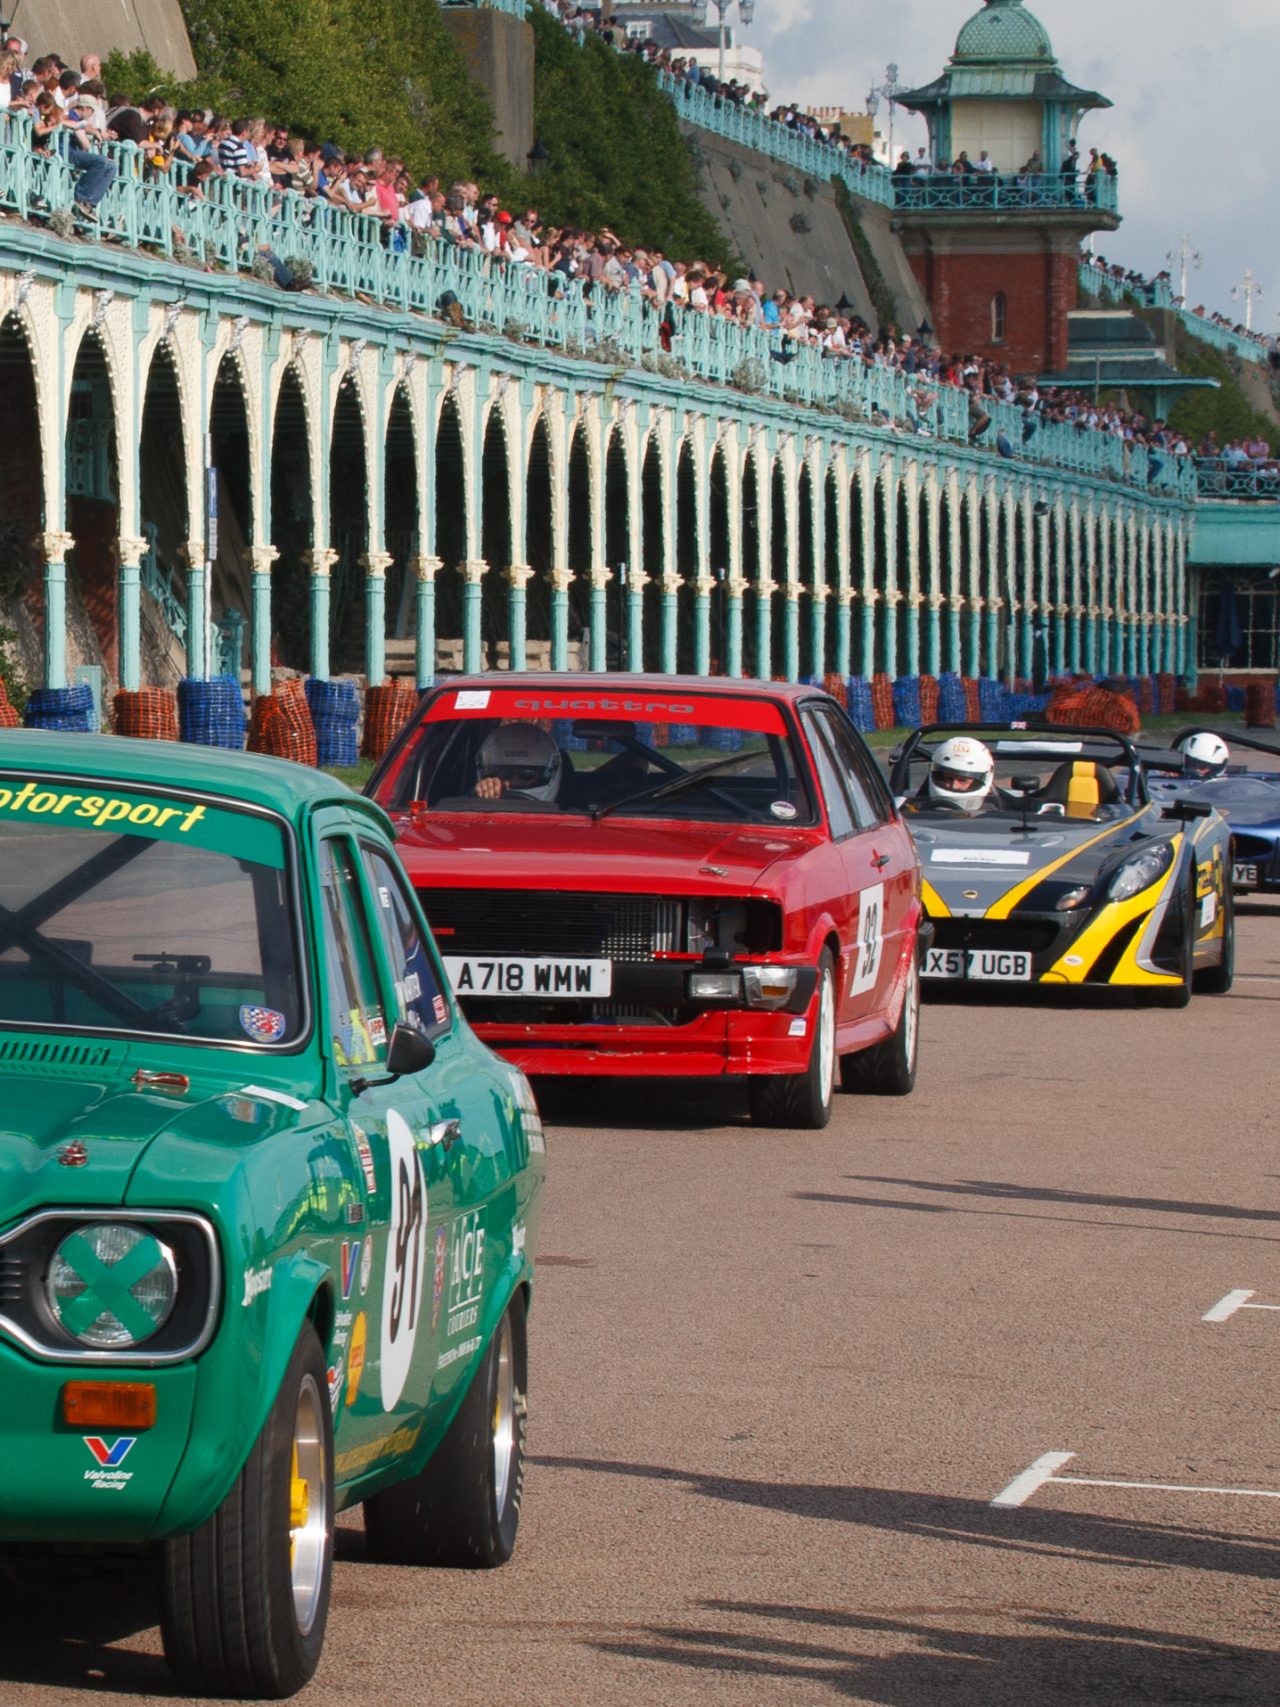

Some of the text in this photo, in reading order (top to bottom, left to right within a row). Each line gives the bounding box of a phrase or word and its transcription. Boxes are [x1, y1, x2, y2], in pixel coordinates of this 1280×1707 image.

[513, 698, 695, 713] quattro
[861, 902, 877, 978] 92
[920, 952, 1027, 975] X57 UGB
[456, 962, 524, 991] A718
[534, 964, 593, 992] WMW
[389, 1147, 422, 1344] 91
[451, 1228, 485, 1286] ACE
[83, 1470, 134, 1480] Valvoline
[91, 1479, 127, 1490] Racing
